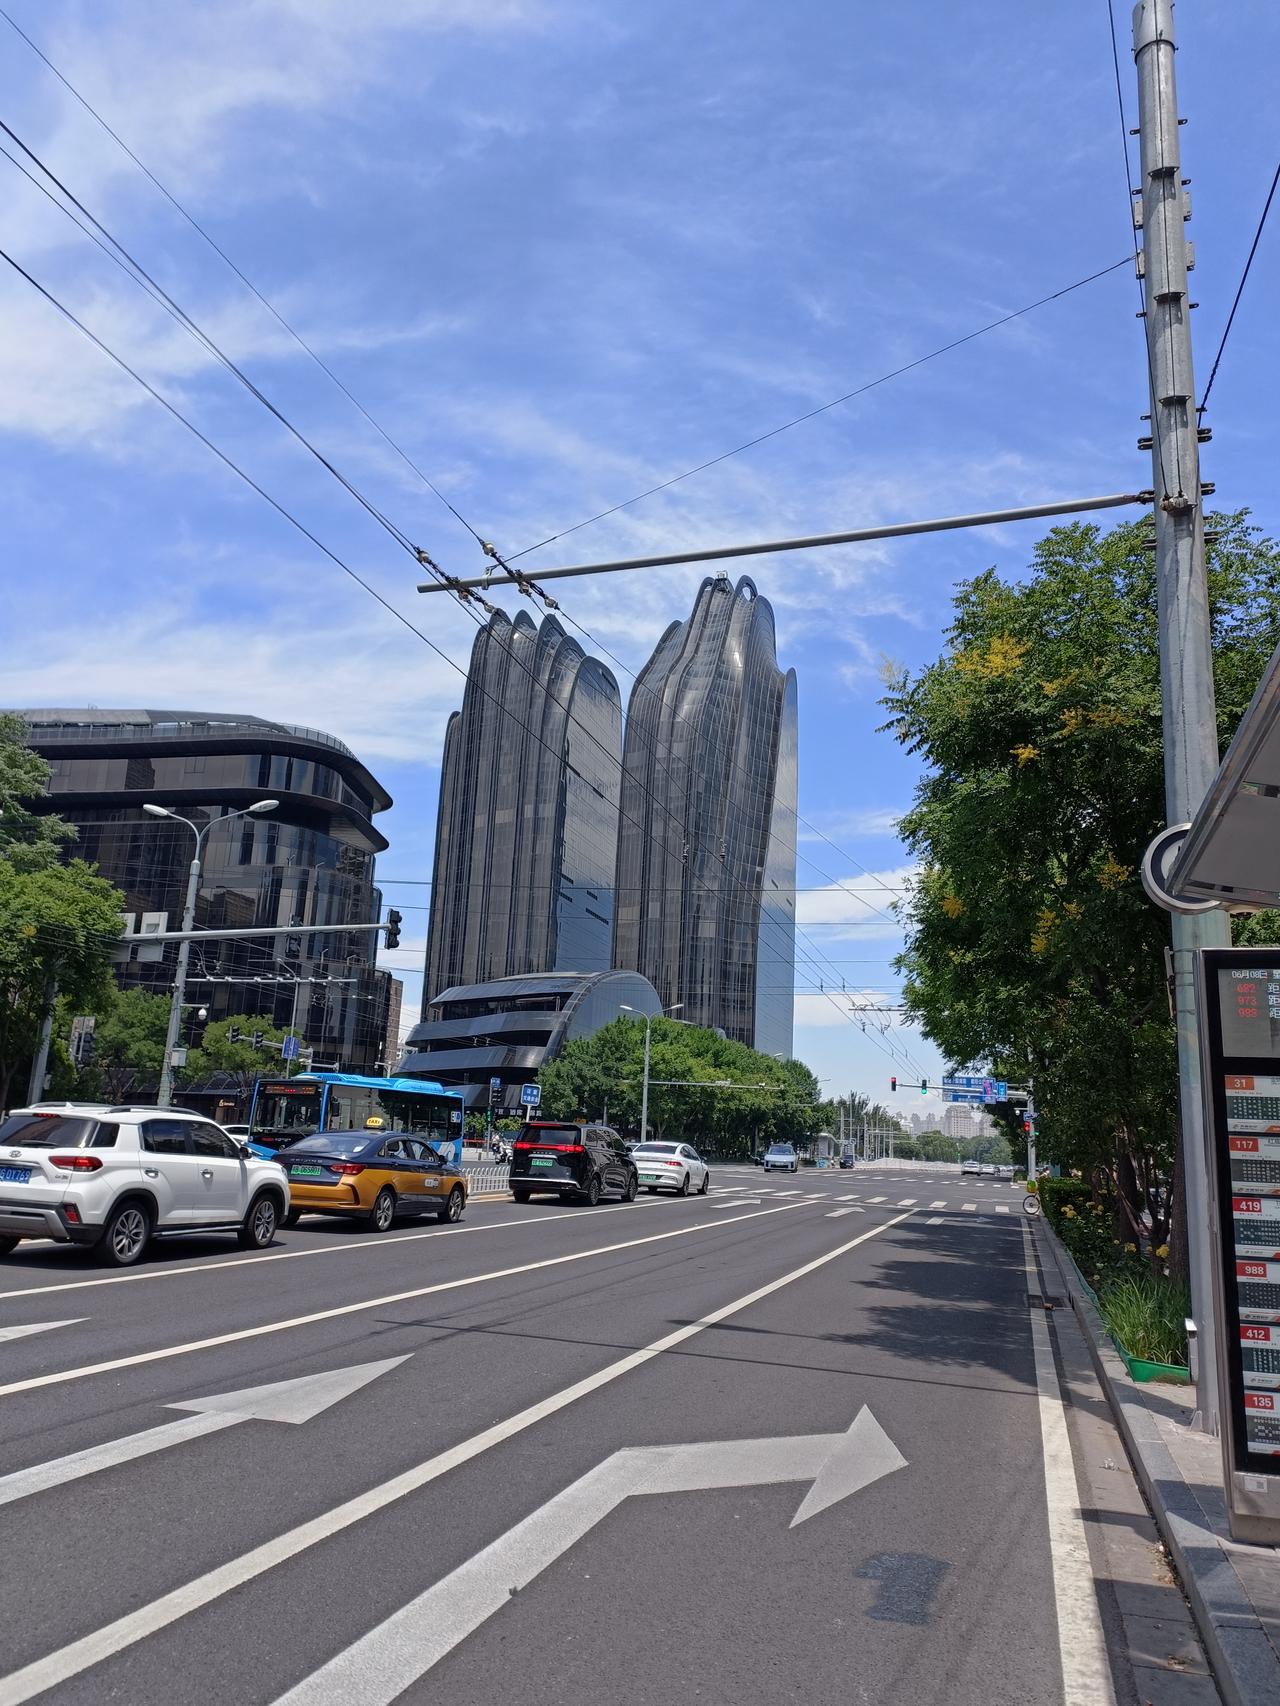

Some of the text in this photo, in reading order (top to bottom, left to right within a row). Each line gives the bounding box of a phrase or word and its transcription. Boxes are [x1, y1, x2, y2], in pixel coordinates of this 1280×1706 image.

[1234, 1079, 1247, 1088] 31
[1235, 1141, 1253, 1149] 117
[1239, 1201, 1260, 1211] 419
[1245, 1265, 1264, 1275] 988
[1246, 1329, 1265, 1339] 412
[1253, 1397, 1272, 1407] 135
